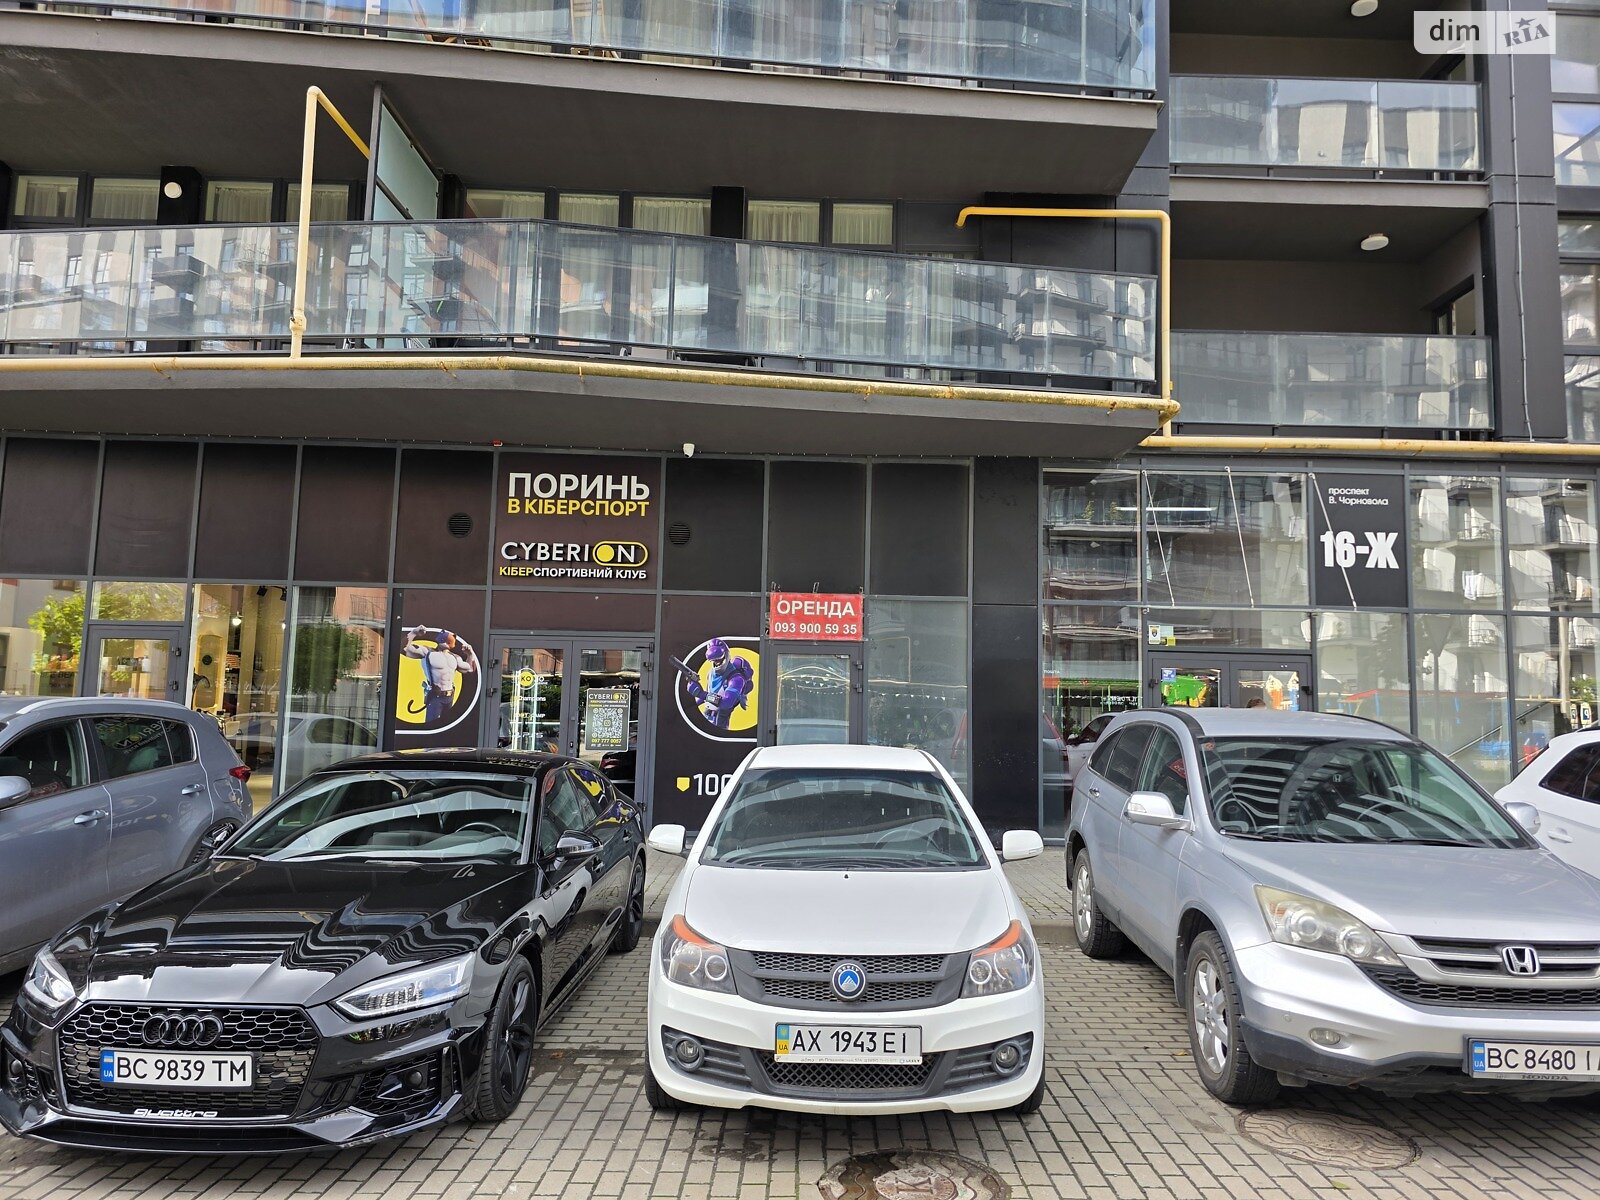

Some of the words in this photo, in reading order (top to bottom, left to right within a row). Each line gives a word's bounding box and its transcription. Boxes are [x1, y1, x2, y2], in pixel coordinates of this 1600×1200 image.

[508, 472, 650, 500] ПОРИНЬ
[1328, 487, 1370, 496] проспект
[507, 498, 521, 514] В
[524, 499, 650, 517] КІБЕРСПОРТ
[1328, 496, 1337, 504] В.
[1338, 496, 1389, 506] Чорновола
[500, 541, 637, 564] CYBERION
[1320, 530, 1400, 569] 16-Ж
[499, 566, 613, 579] КІБЕРСПОРТИВНИЙ
[615, 569, 647, 579] КЛУБ
[776, 600, 855, 618] ОРЕНДА
[774, 622, 796, 633] 093
[799, 623, 821, 634] 900
[824, 623, 839, 634] 59
[842, 624, 857, 634] 35
[792, 1030, 822, 1052] AX
[830, 1030, 877, 1053] 1943
[883, 1032, 906, 1054] EI
[1487, 1047, 1519, 1069] BC
[1524, 1049, 1576, 1070] 8480
[1586, 1050, 1600, 1071] I
[103, 1070, 113, 1078] UA
[117, 1056, 148, 1079] BC
[154, 1058, 205, 1081] 9839
[212, 1060, 247, 1082] TM
[133, 1108, 218, 1117] quattro
